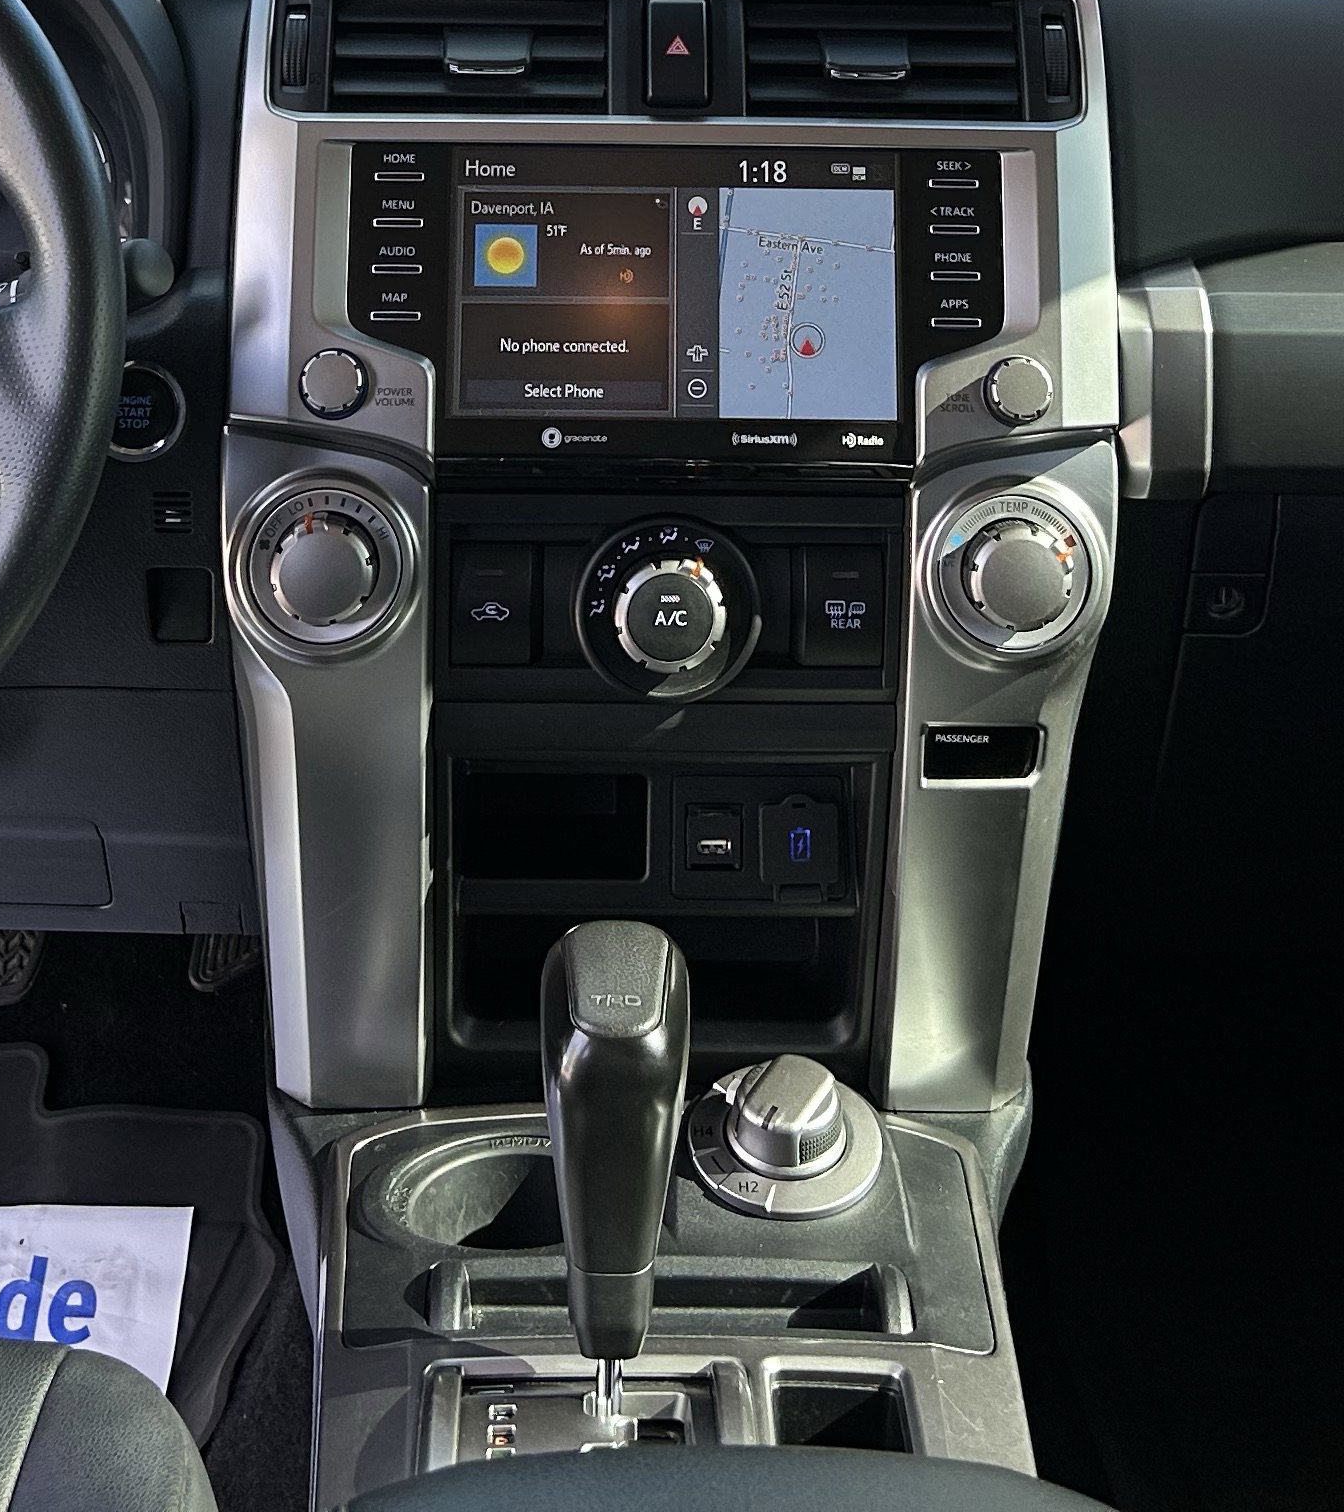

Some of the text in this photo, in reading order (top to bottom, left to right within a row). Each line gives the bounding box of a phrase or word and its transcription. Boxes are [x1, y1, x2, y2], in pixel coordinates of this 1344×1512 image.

[383, 153, 416, 164] HOME
[464, 159, 516, 177] Home
[739, 160, 788, 183] 1:18
[936, 161, 962, 171] SEEK
[382, 199, 415, 210] MENU
[471, 201, 554, 217] Davenport, IA
[940, 206, 975, 217] TRACK
[693, 218, 702, 231] E
[379, 246, 416, 257] AUDIO
[580, 243, 593, 256] As
[594, 243, 606, 255] of
[634, 246, 652, 258] ago
[758, 236, 824, 255] Eastern Ave
[935, 253, 972, 263] PHONE
[778, 281, 791, 299] 52
[381, 292, 408, 304] MAP
[940, 299, 969, 310] APPS
[500, 338, 630, 355] No phone connected.
[377, 387, 413, 397] POWER
[524, 384, 604, 399] Select Phone
[118, 395, 152, 405] ENGINE
[374, 397, 416, 407] VOLUME
[117, 407, 152, 417] START
[939, 403, 975, 413] SCROLL
[119, 419, 150, 429] STOP
[564, 434, 607, 444] gracenote
[740, 434, 789, 444] SiriusXM
[858, 435, 884, 446] Radio
[287, 501, 304, 516] LO
[999, 501, 1029, 513] TEMP
[264, 514, 283, 539] OFF
[654, 610, 688, 627] A/C
[830, 618, 862, 630] REAR
[935, 733, 989, 744] PASSENGER
[590, 993, 642, 1008] TRD
[693, 1125, 714, 1137] H4
[738, 1180, 760, 1194] H2
